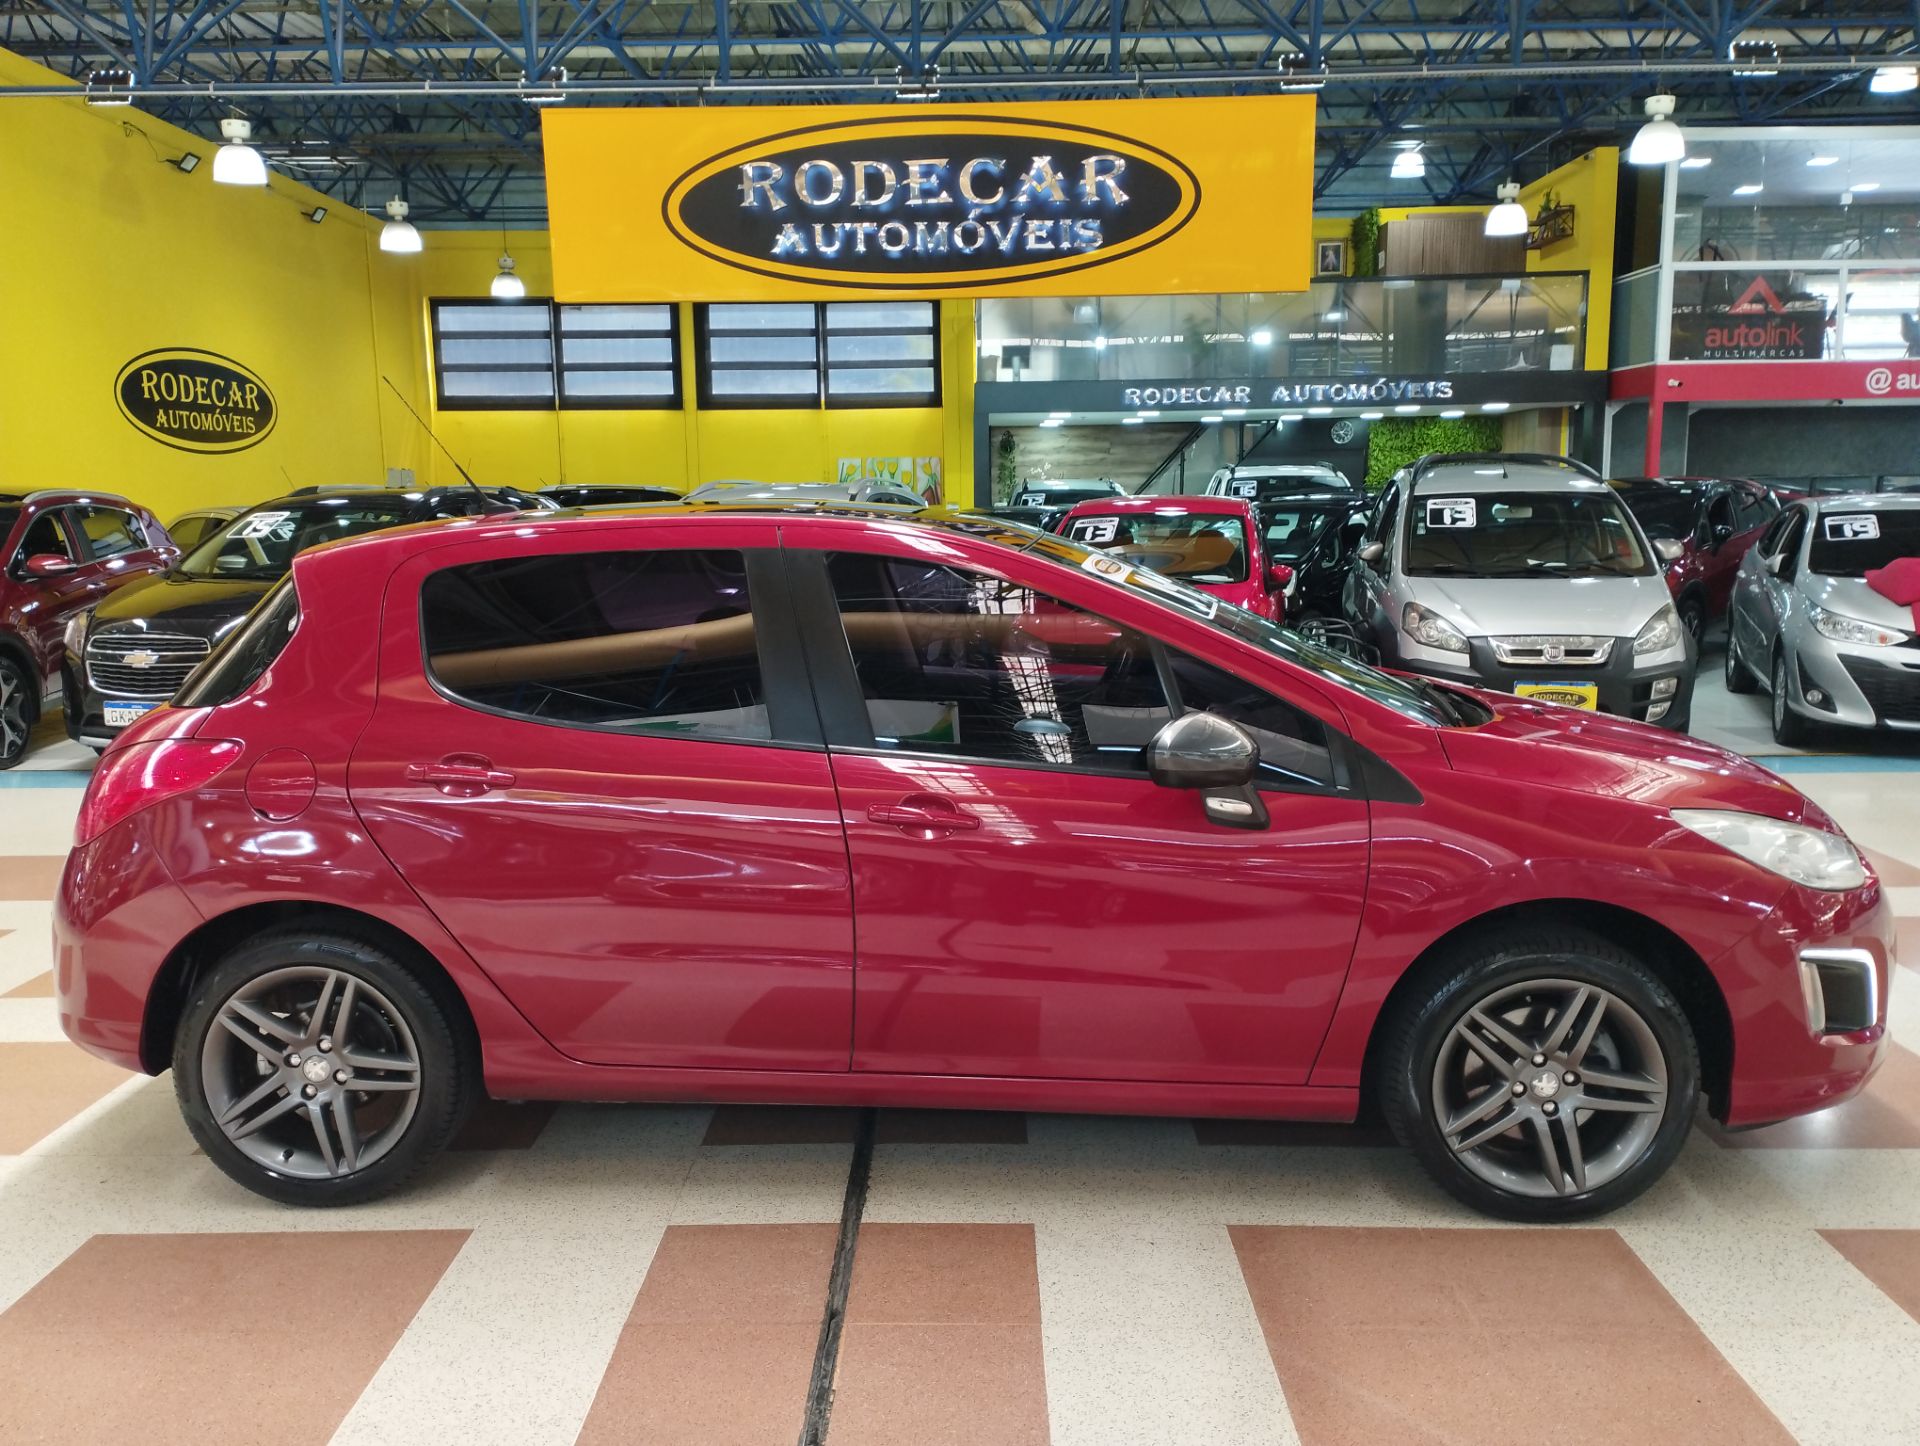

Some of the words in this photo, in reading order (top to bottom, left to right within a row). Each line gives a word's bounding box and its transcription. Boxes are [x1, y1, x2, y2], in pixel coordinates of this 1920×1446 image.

[737, 155, 1130, 211] RODECAR
[769, 208, 1104, 254] AUTOMÓVEIS
[1704, 323, 1804, 347] autolink
[1703, 349, 1805, 359] MULTIMARCAS
[141, 369, 260, 412] RODECAR
[1124, 385, 1250, 405] RODECAR
[1272, 378, 1454, 402] AUTOMÓVEIS
[156, 408, 256, 434] AUTOMÓVEIS
[1085, 524, 1115, 541] 13
[1843, 522, 1877, 538] 19
[1533, 693, 1579, 702] RODECAR
